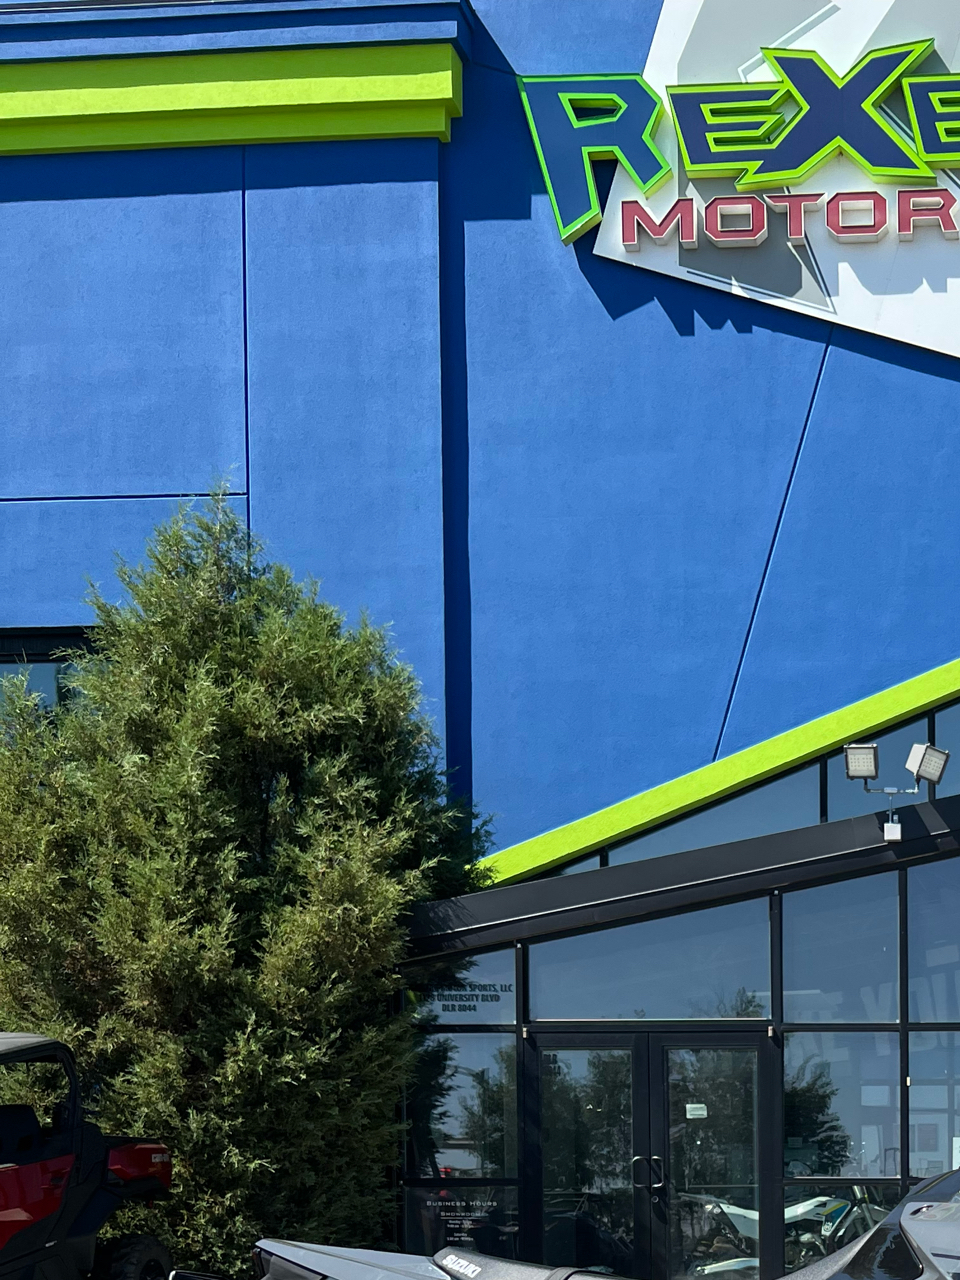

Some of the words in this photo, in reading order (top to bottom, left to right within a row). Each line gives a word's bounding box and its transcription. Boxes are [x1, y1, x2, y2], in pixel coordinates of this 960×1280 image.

[500, 984, 514, 993] LLC
[437, 993, 479, 1003] UNIVERSITY
[481, 994, 501, 1003] BLVD
[442, 1004, 456, 1013] DLR
[458, 1004, 477, 1013] 8044
[442, 1255, 482, 1278] SUZUKI
